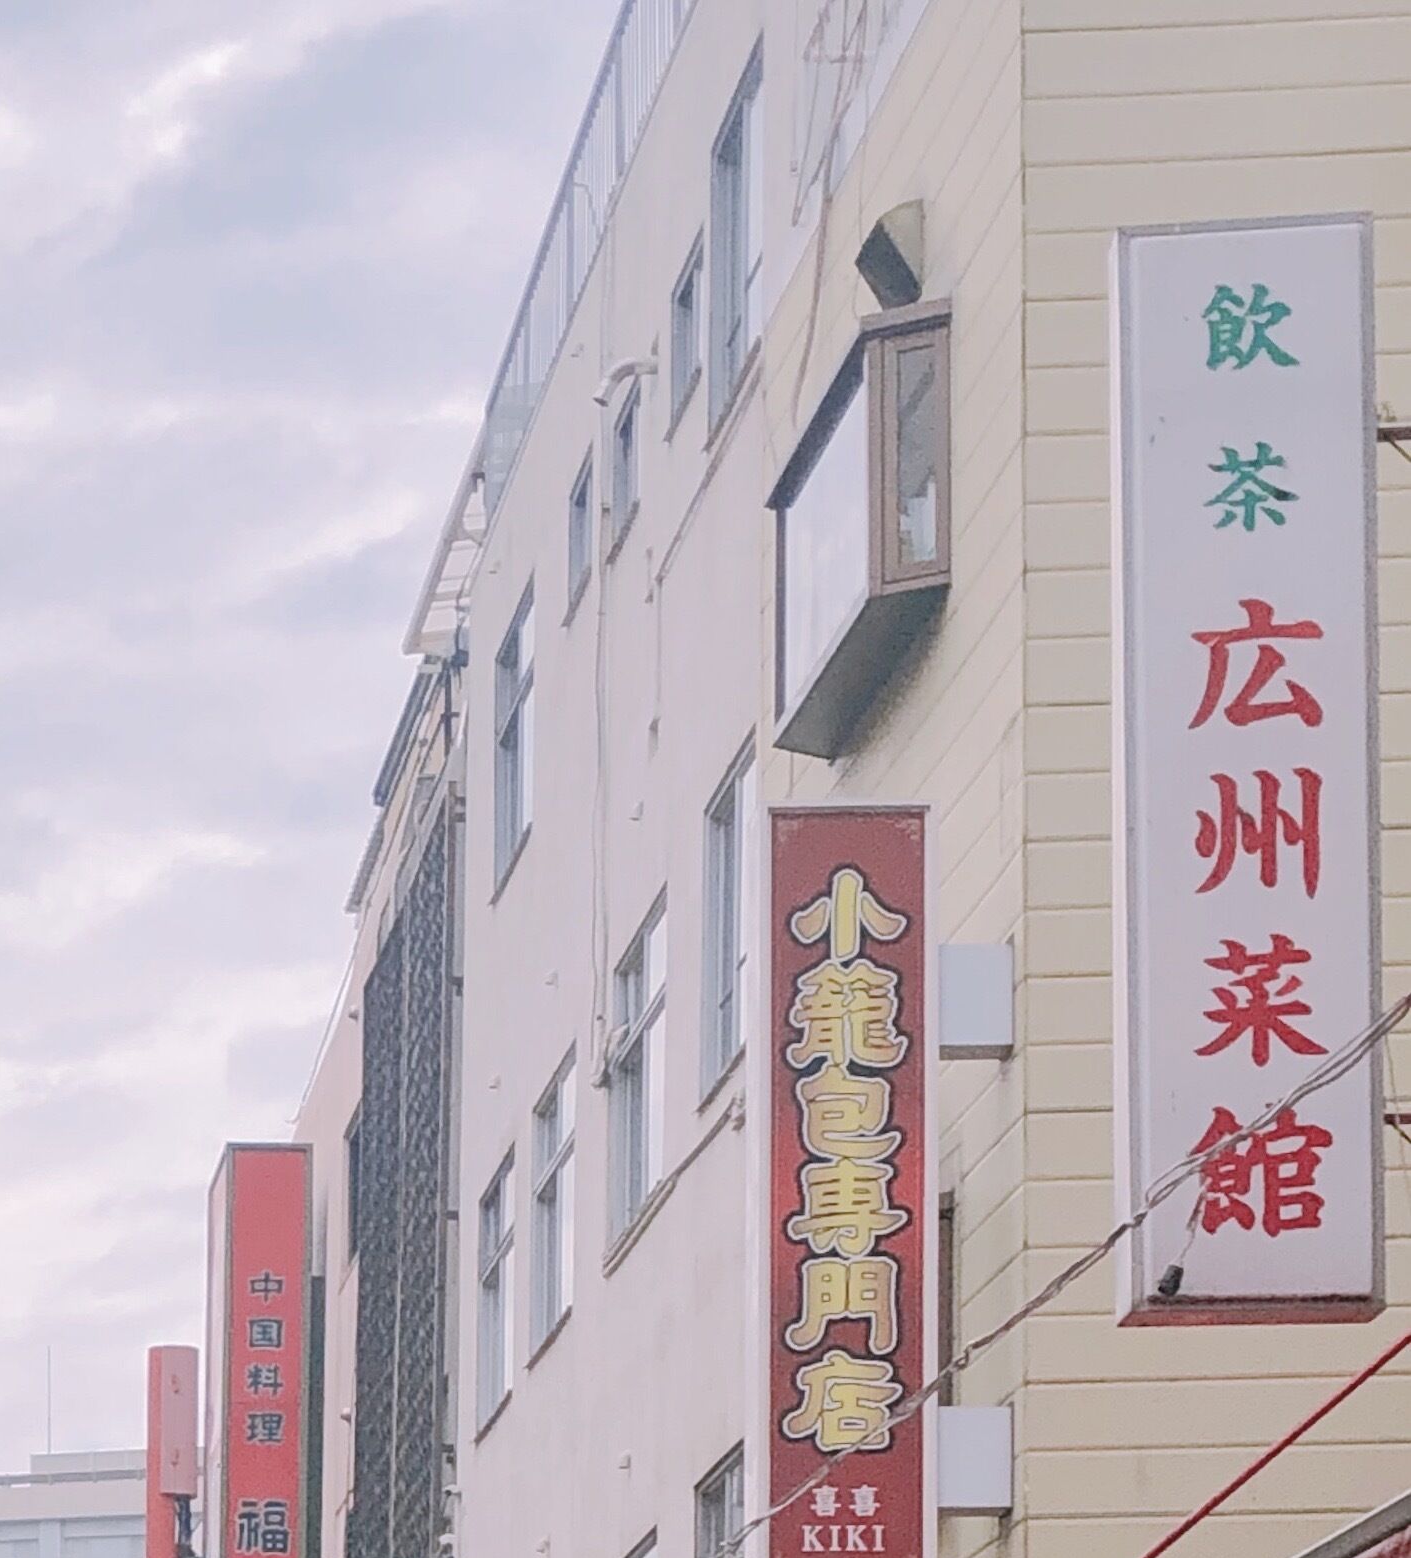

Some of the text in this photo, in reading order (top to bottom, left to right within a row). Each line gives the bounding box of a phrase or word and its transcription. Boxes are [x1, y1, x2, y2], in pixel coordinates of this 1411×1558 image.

[245, 1269, 284, 1446] 中国料理
[810, 1483, 881, 1518] 喜喜
[801, 1523, 885, 1553] KIKI
